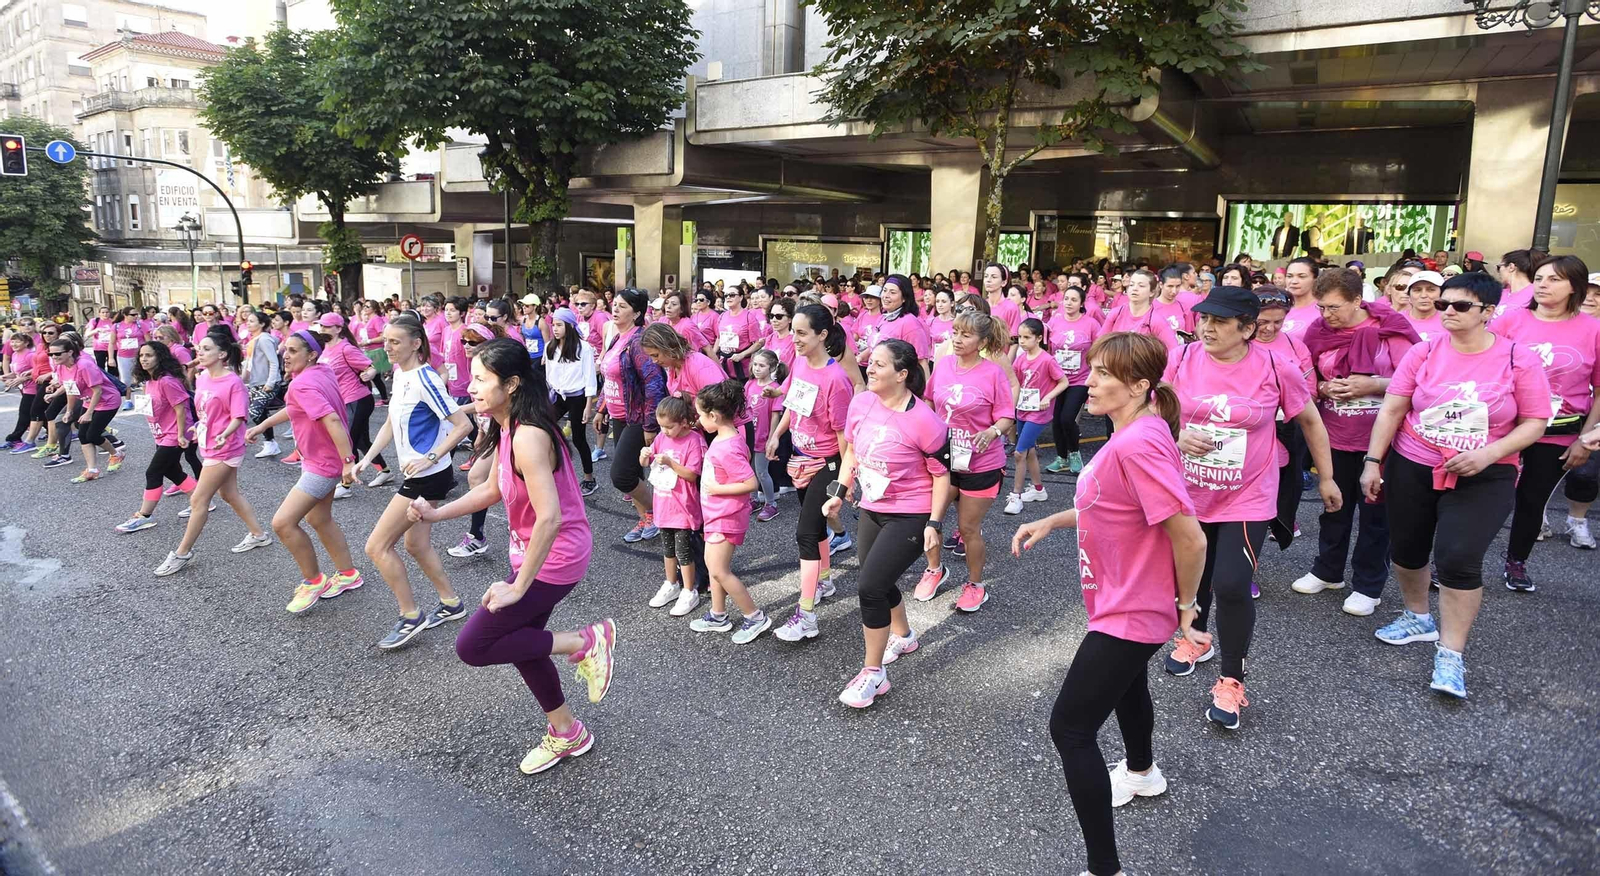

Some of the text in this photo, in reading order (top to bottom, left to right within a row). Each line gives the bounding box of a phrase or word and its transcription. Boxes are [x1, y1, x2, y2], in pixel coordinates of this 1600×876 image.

[160, 185, 195, 195] EDIFICIO
[159, 196, 198, 206] EN VENTA
[1444, 410, 1463, 420] 441
[1181, 456, 1242, 481] FEMENINA
